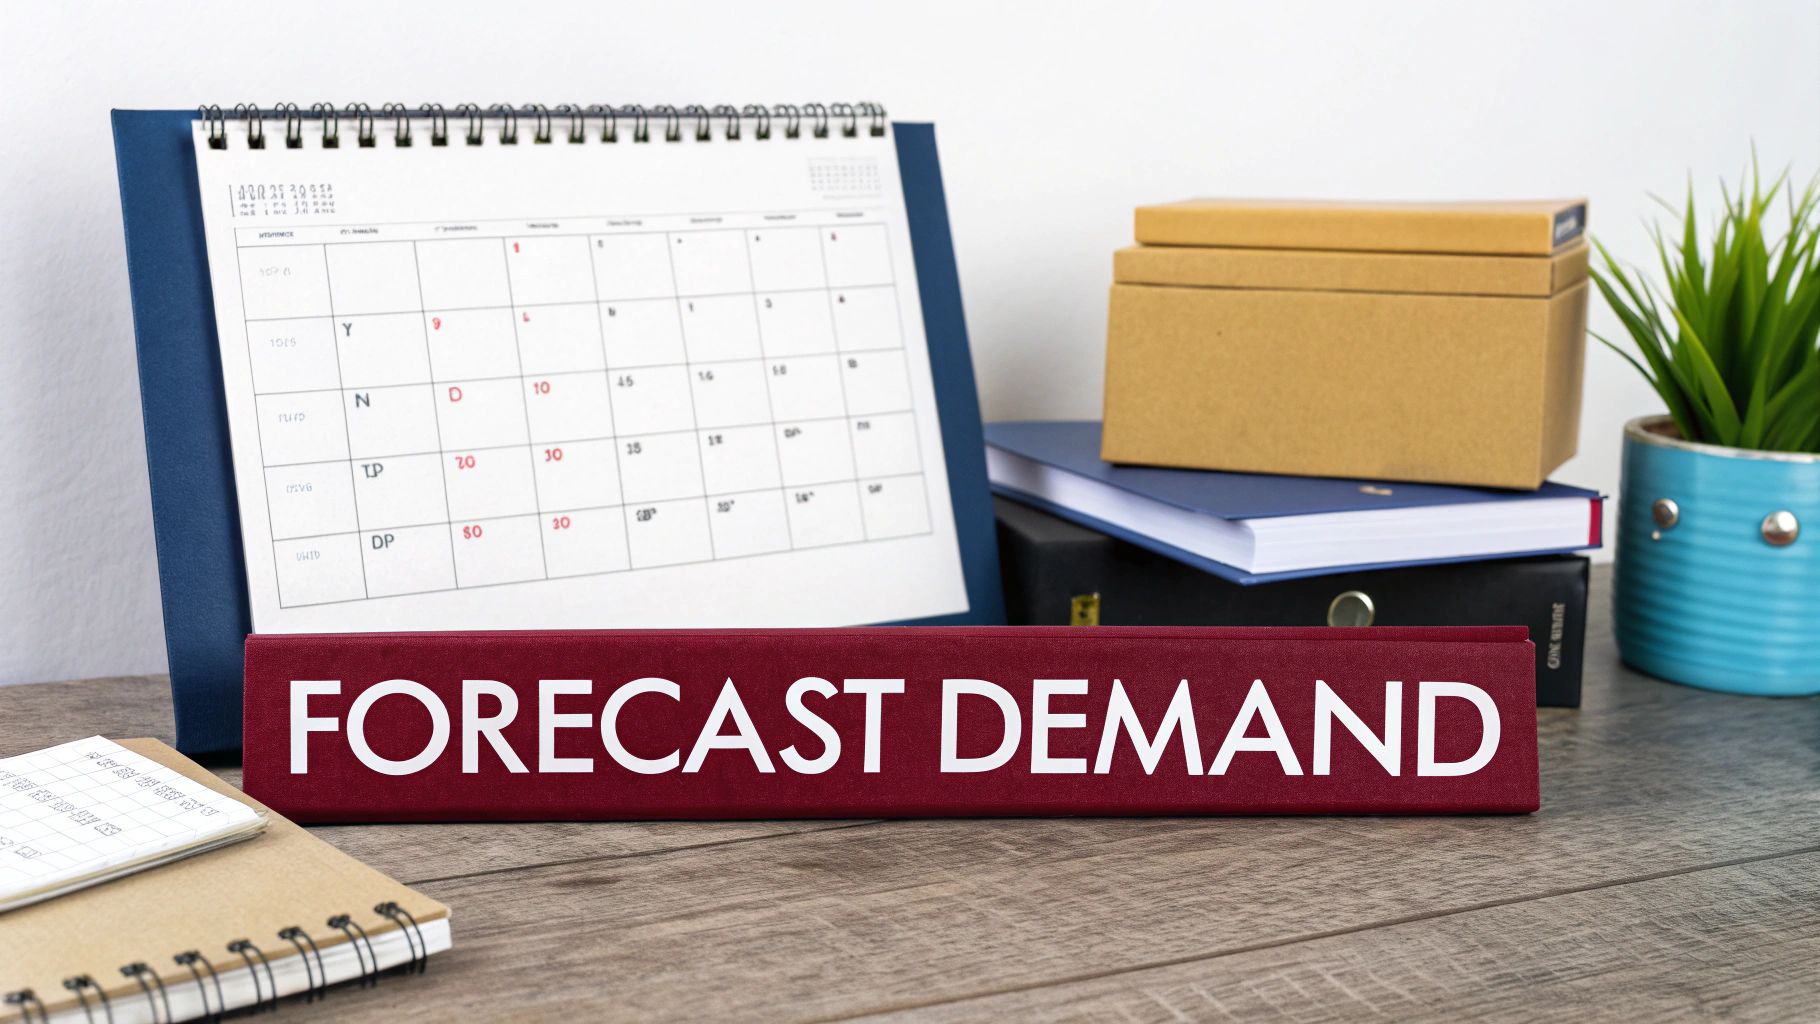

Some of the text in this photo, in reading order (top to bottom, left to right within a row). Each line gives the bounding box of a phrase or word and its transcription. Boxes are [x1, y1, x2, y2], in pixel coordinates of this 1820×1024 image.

[342, 321, 353, 337] Y
[354, 392, 371, 408] N
[371, 533, 395, 550] DP
[288, 676, 1502, 777] FORECAST DEMAND
